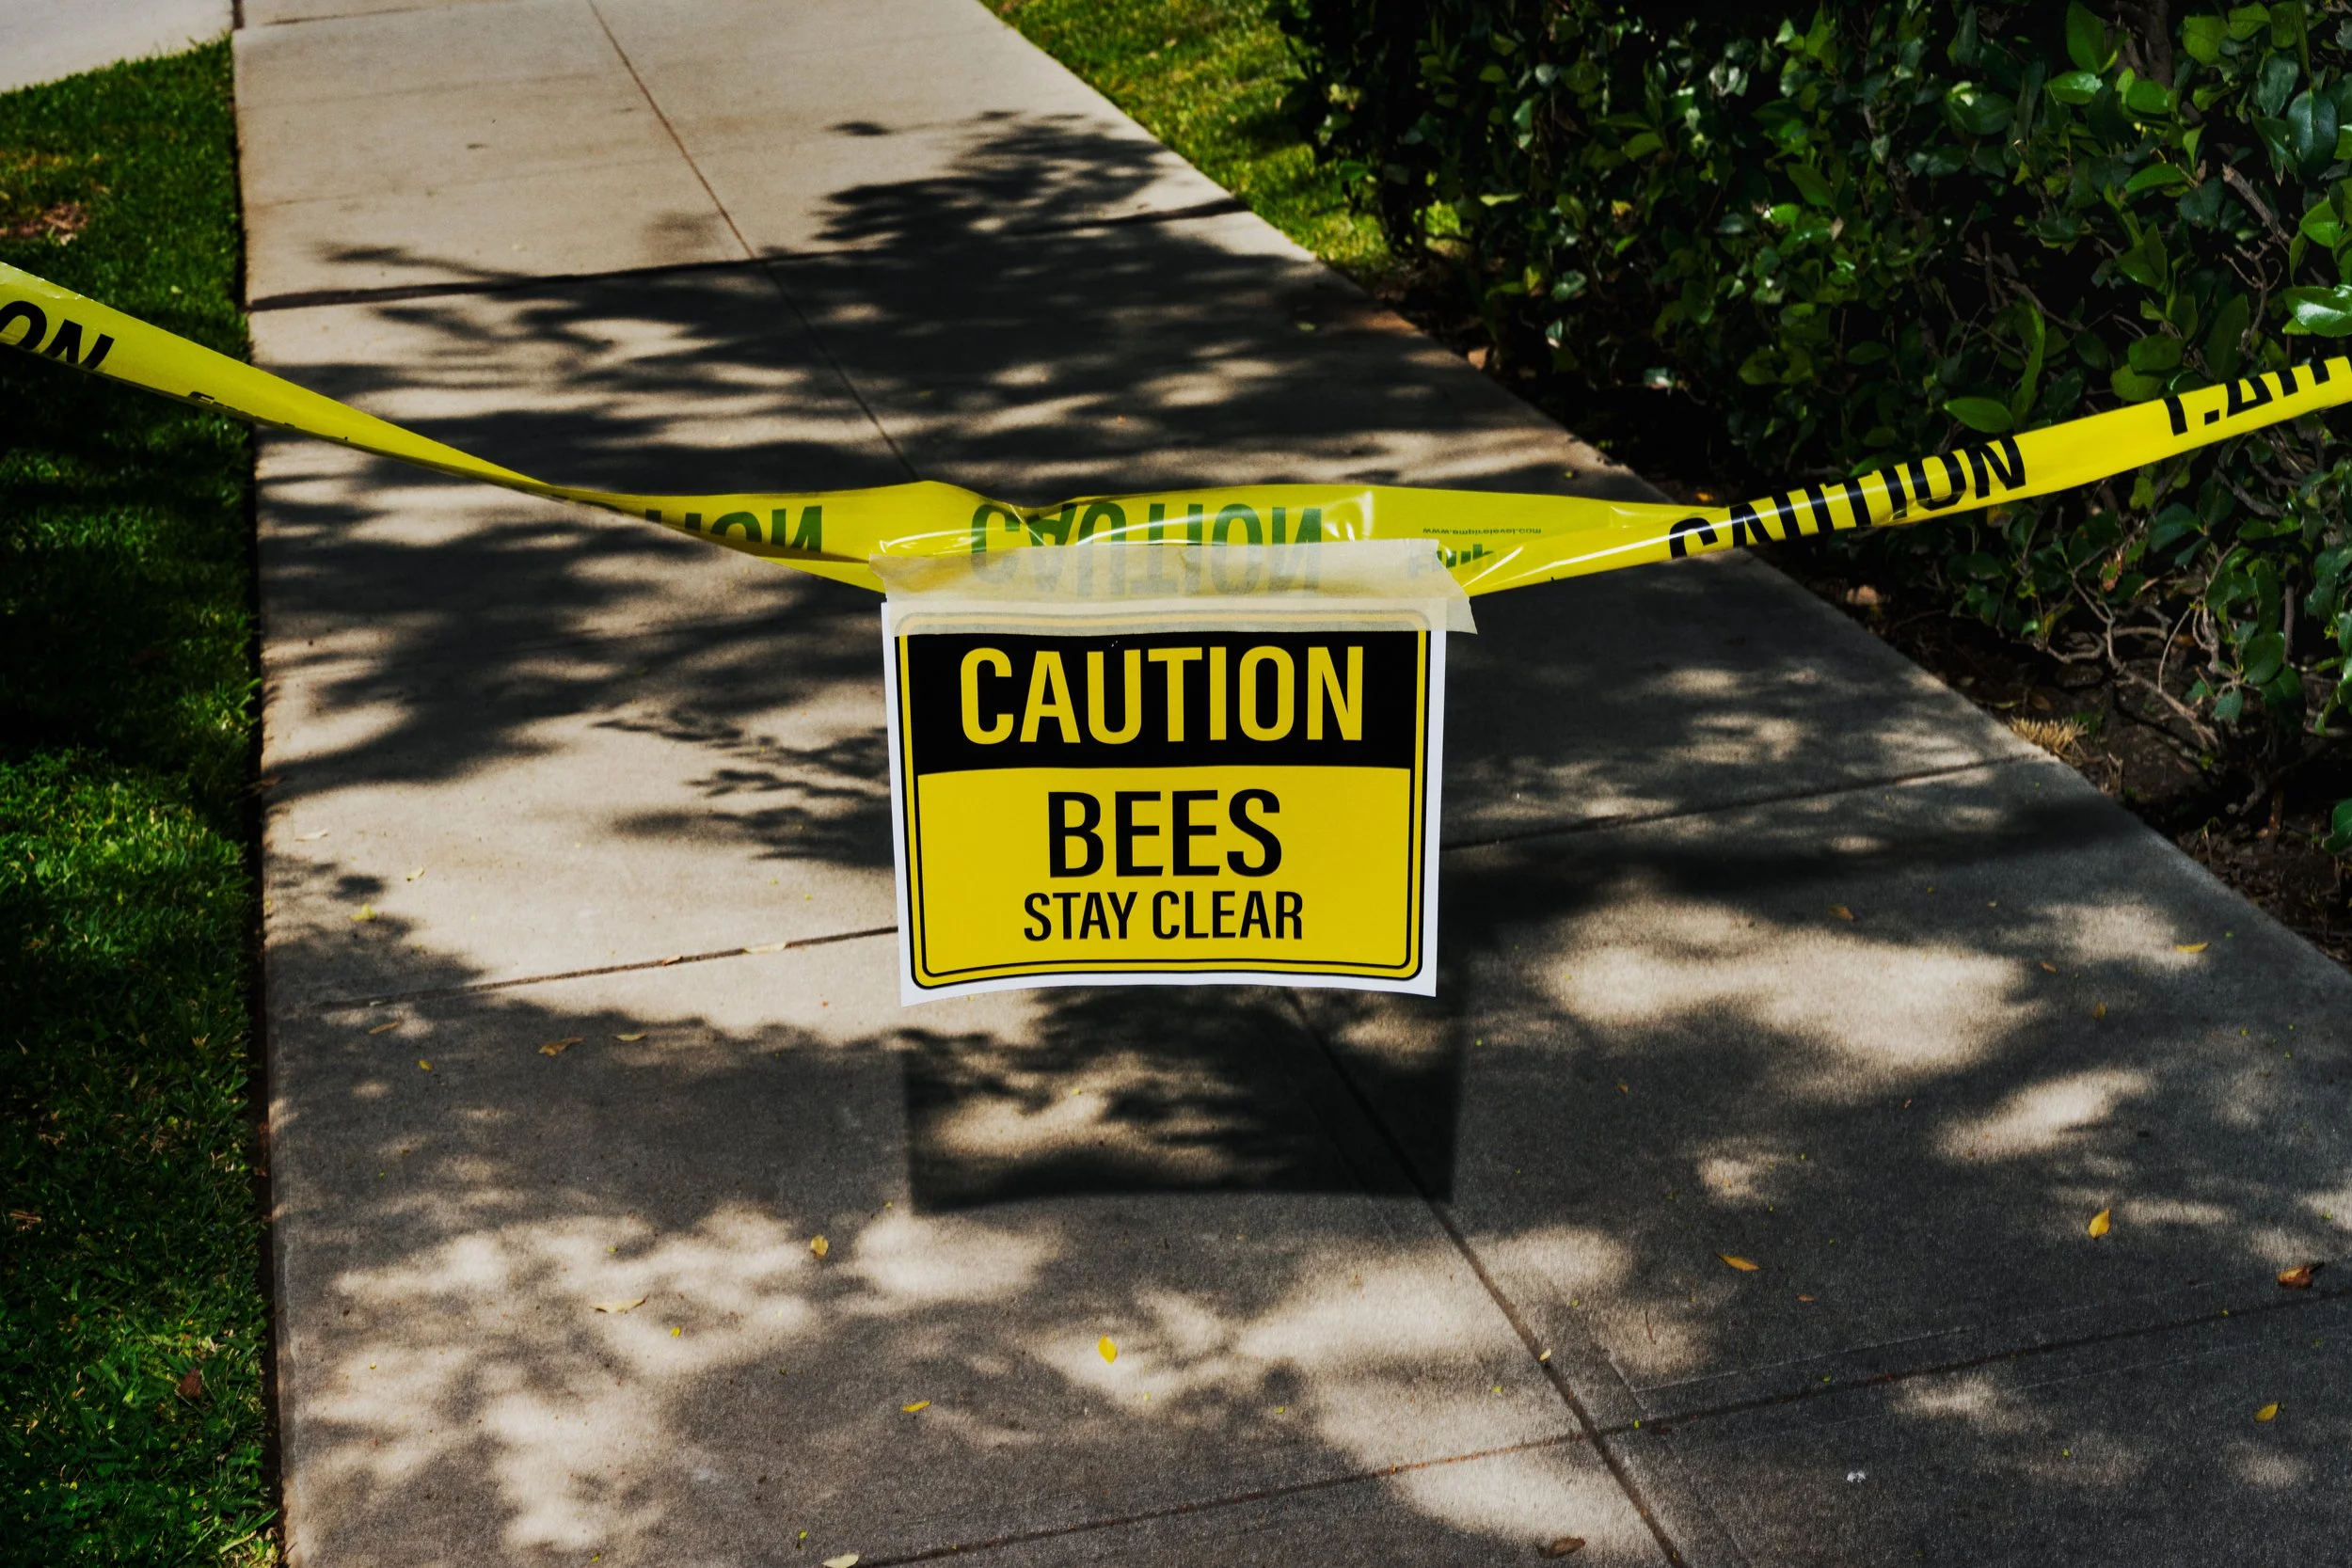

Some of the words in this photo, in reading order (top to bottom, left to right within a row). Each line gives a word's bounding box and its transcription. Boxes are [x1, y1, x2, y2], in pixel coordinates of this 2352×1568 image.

[960, 646, 1364, 745] CAUTION
[1047, 788, 1282, 879] BEES
[1024, 891, 1137, 942] STAY
[1152, 890, 1304, 941] CLEAR
